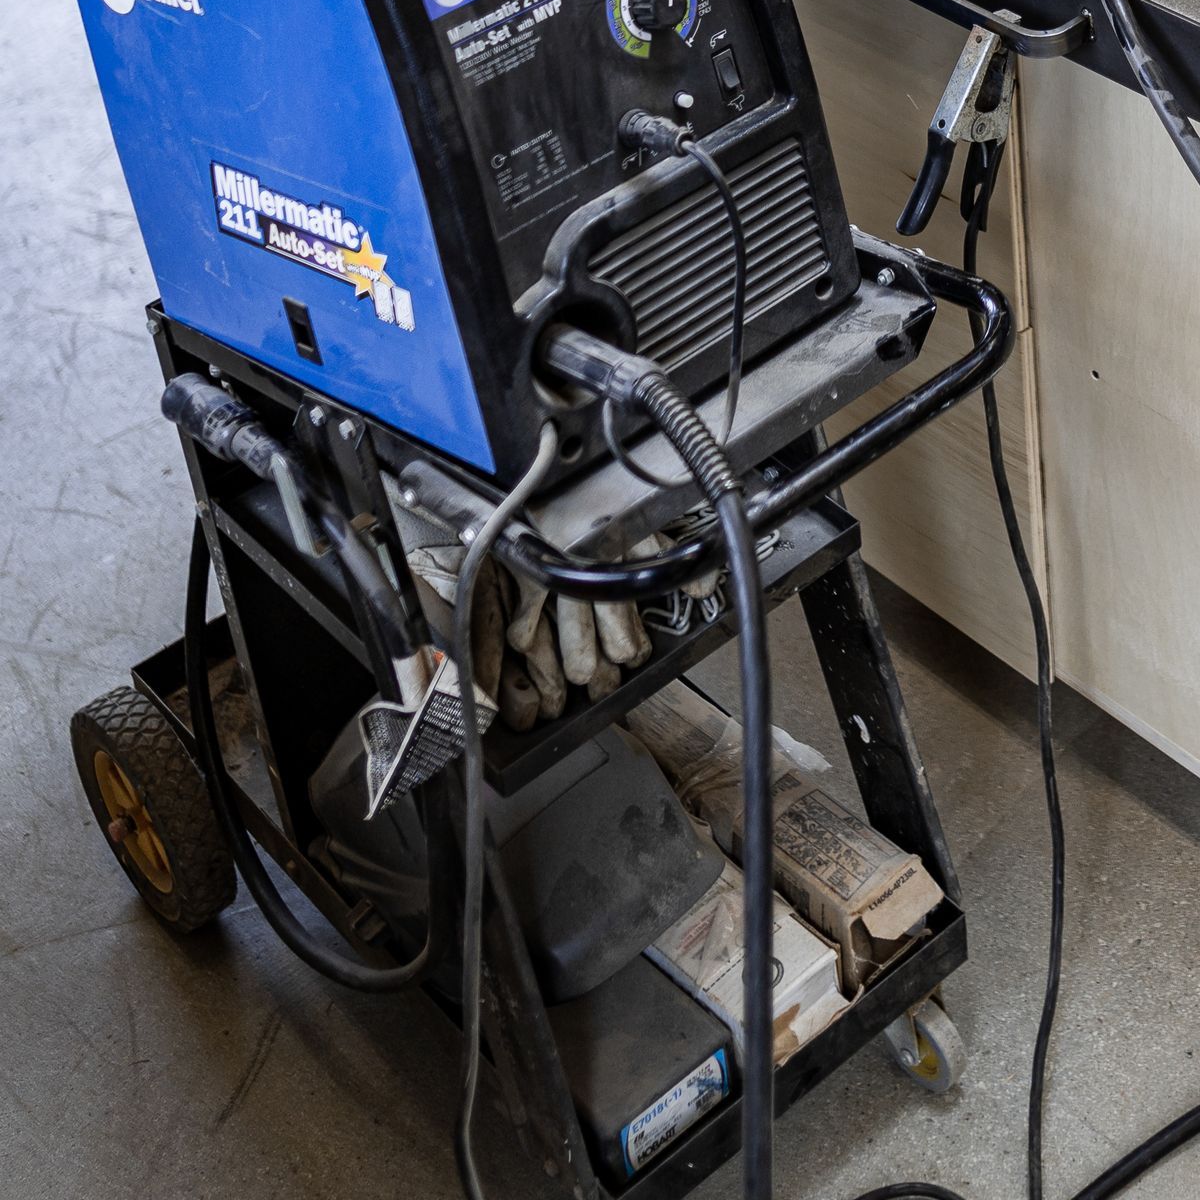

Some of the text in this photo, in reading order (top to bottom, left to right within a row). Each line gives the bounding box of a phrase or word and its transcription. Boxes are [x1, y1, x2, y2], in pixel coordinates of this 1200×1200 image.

[455, 28, 512, 63] Auto-Set
[516, 17, 535, 33] with
[533, 0, 563, 24] MVP
[213, 165, 361, 249] Millermatic
[219, 199, 263, 241] 211
[268, 223, 346, 273] Auto-Set
[631, 1087, 683, 1134] E7018(-1)
[637, 1123, 678, 1163] HOBART
